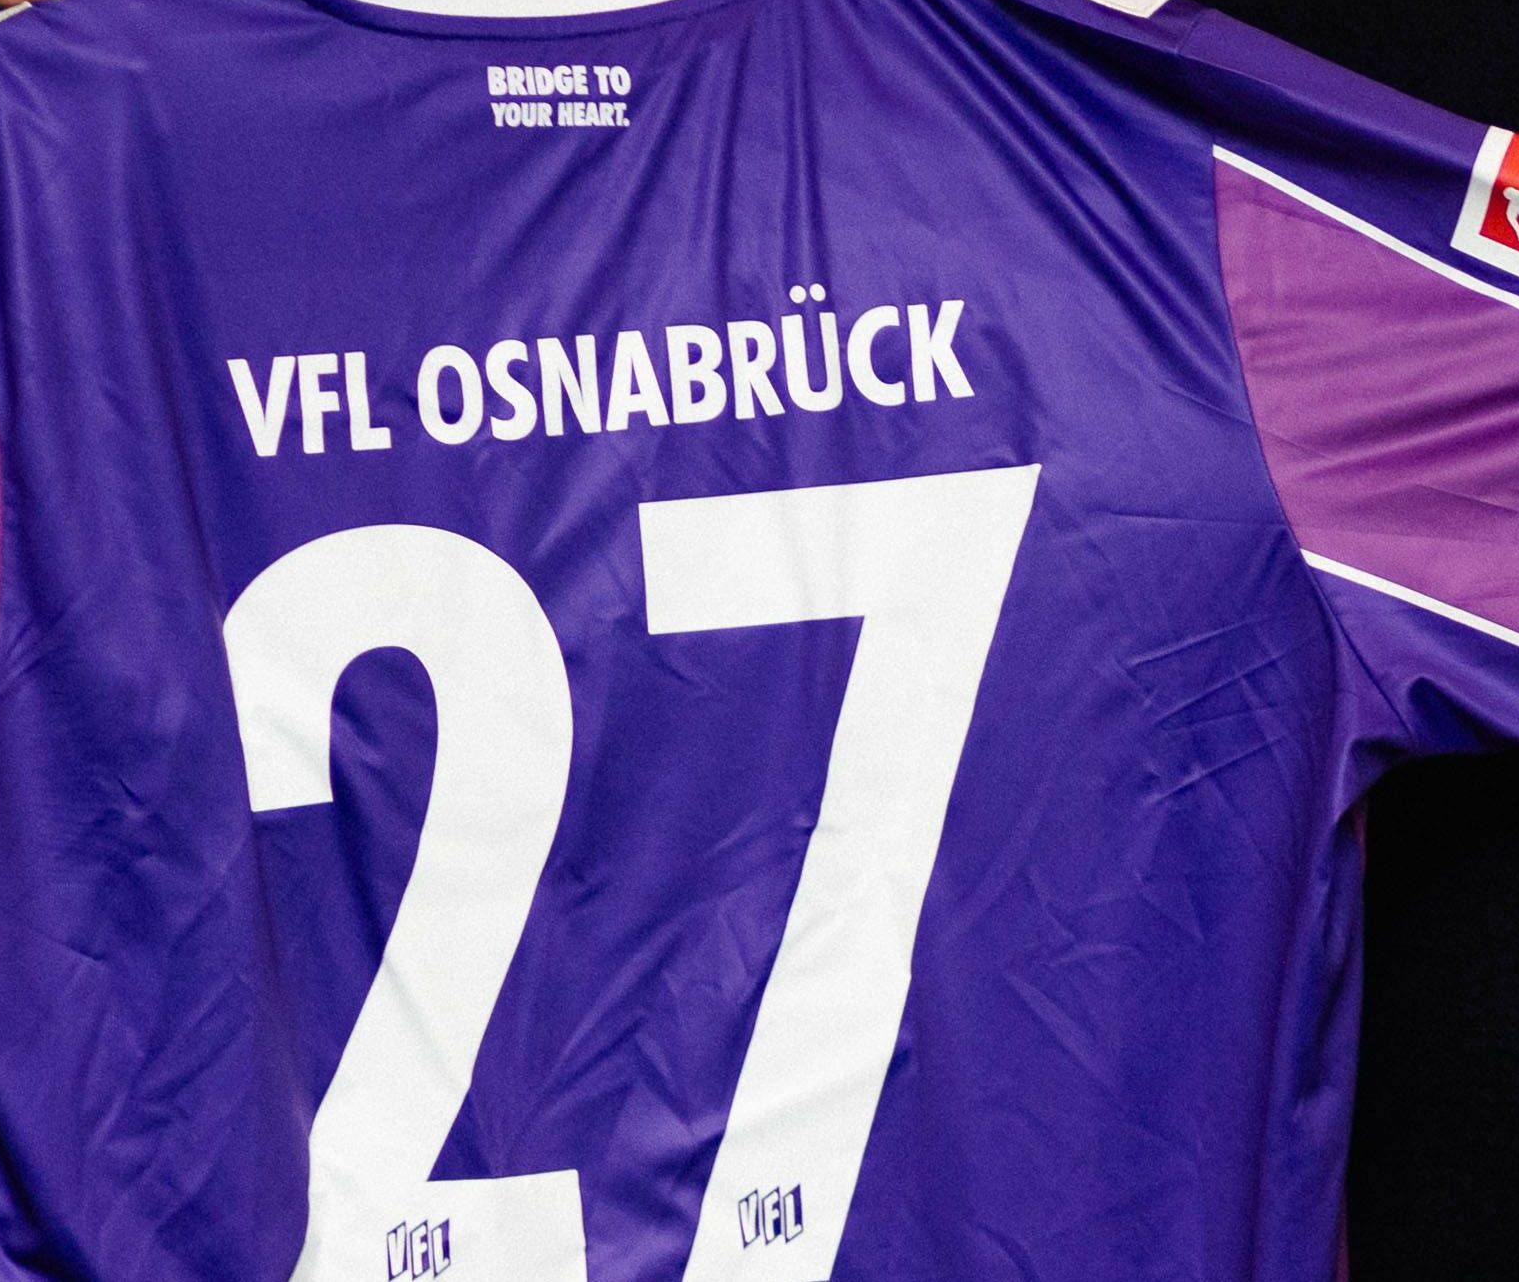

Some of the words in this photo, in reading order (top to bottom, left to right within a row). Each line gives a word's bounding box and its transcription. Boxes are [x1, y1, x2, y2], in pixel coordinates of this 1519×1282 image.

[487, 65, 589, 96] BRIDGE
[593, 65, 632, 96] TO
[490, 102, 553, 127] YOUR
[557, 102, 630, 127] HEART.
[226, 351, 392, 457] VFL
[417, 283, 976, 445] OSNABRÜCK
[222, 463, 1043, 1282] 27
[738, 1184, 804, 1249] VFL
[386, 1219, 452, 1281] VFL
